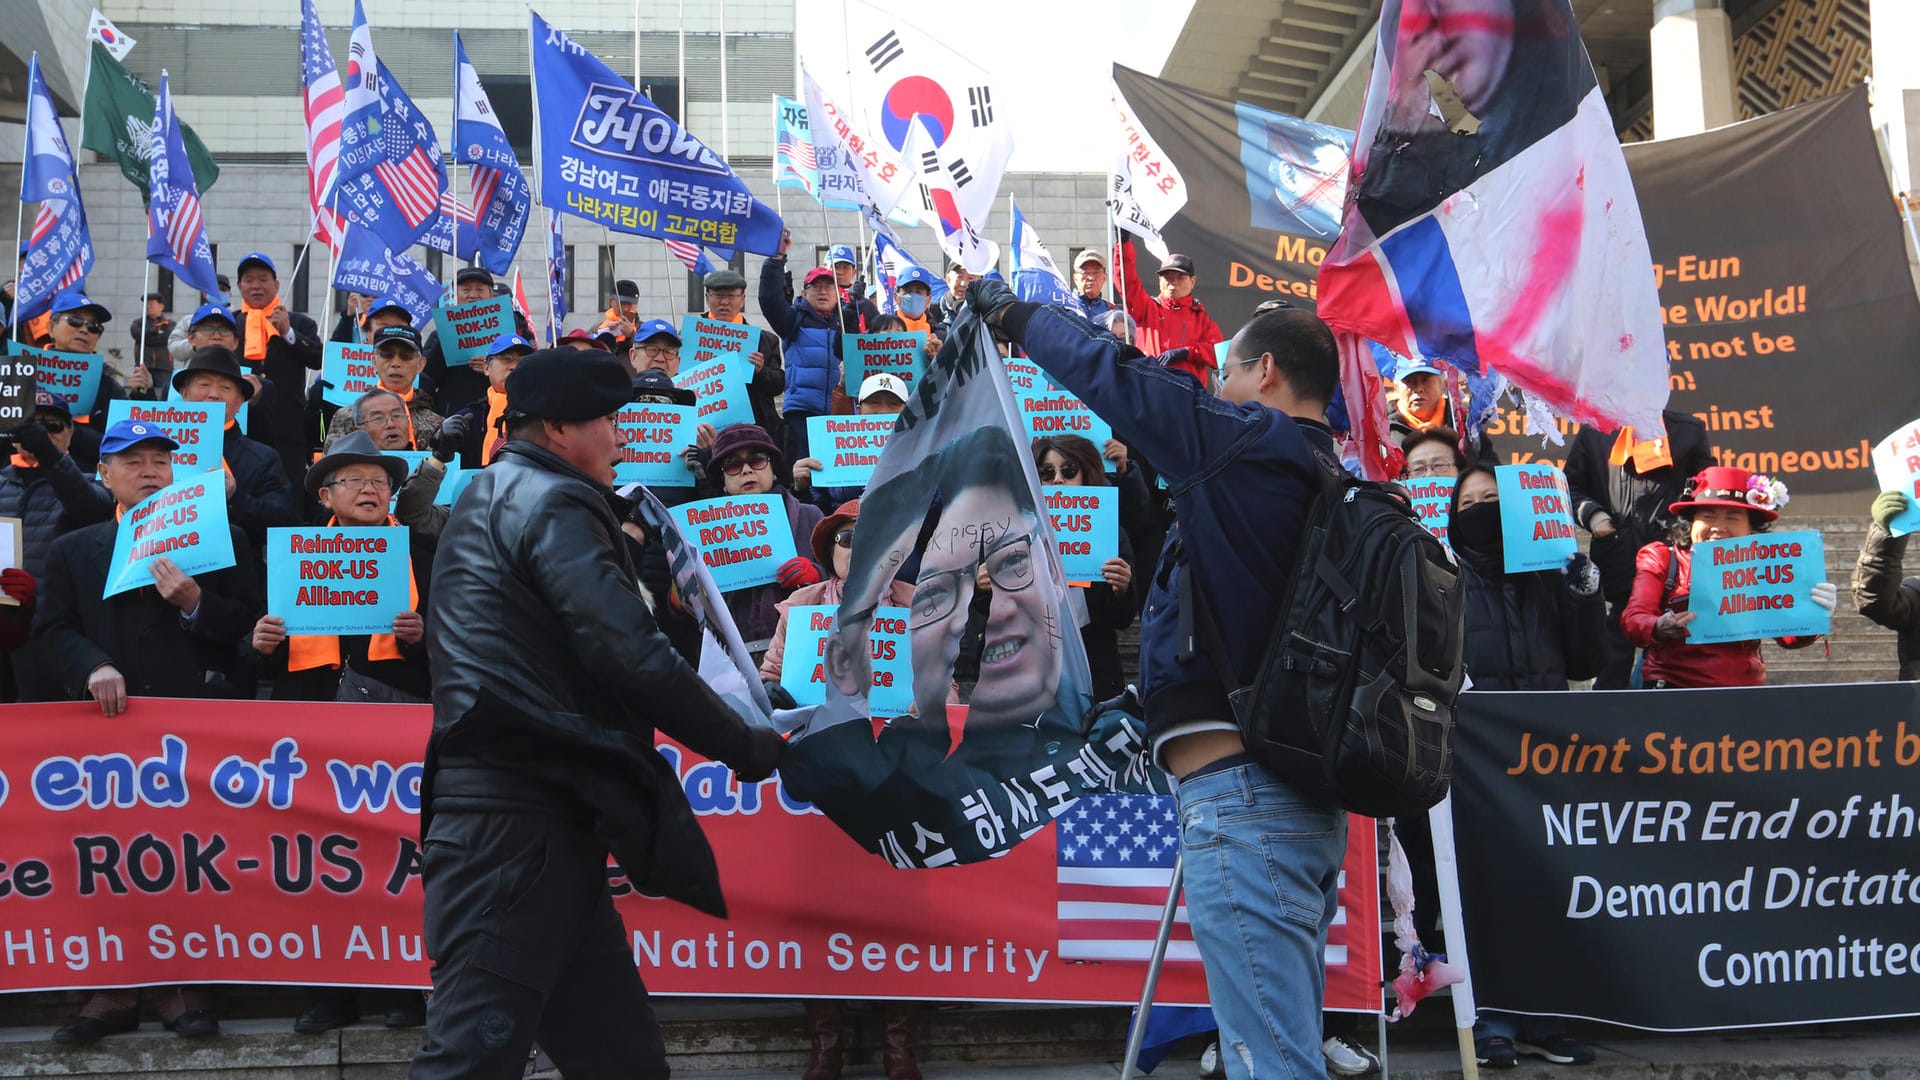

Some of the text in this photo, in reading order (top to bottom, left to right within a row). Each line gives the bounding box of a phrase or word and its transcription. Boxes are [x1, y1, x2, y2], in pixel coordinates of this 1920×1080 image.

[783, 106, 809, 131] 자유
[560, 155, 752, 218] 경남여고 애국동지회
[566, 191, 738, 245] 나라지킴이 고교연합
[447, 303, 501, 321] Reinforce
[1694, 285, 1807, 323] World!
[455, 319, 499, 335] ROK-US
[695, 321, 749, 340] Reinforce
[698, 336, 741, 353] ROK-US
[857, 337, 917, 350] Reinforce
[1689, 336, 1747, 360] not
[1752, 331, 1796, 354] be
[15, 361, 35, 376] to
[864, 353, 913, 366] ROK-US
[36, 369, 82, 388] OK-US
[130, 406, 208, 423] Reinforce
[1032, 415, 1092, 432] ROK-US
[131, 483, 205, 524] Reinforce
[687, 501, 769, 525] Reinforce
[133, 504, 198, 541] ROK-US
[699, 520, 768, 546] ROK-US
[128, 531, 199, 563] Alliance
[291, 534, 387, 553] Reinforce
[702, 544, 772, 568] Alliance
[1713, 541, 1802, 566] Reinforce
[300, 560, 378, 579] ROK-US
[1722, 564, 1794, 590] ROK-US
[295, 587, 379, 606] Alliance
[1718, 593, 1795, 616] Alliance
[1506, 732, 1632, 776] Joint
[1638, 723, 1884, 776] Statement
[31, 734, 190, 811] end
[210, 737, 308, 809] of
[1541, 794, 1920, 846] NEVER End of th
[74, 832, 364, 896] ROK-US
[1566, 866, 1754, 919] Demand
[4, 926, 124, 972] High
[148, 924, 323, 961] School
[632, 930, 803, 970] Nation
[826, 932, 1050, 983] Security
